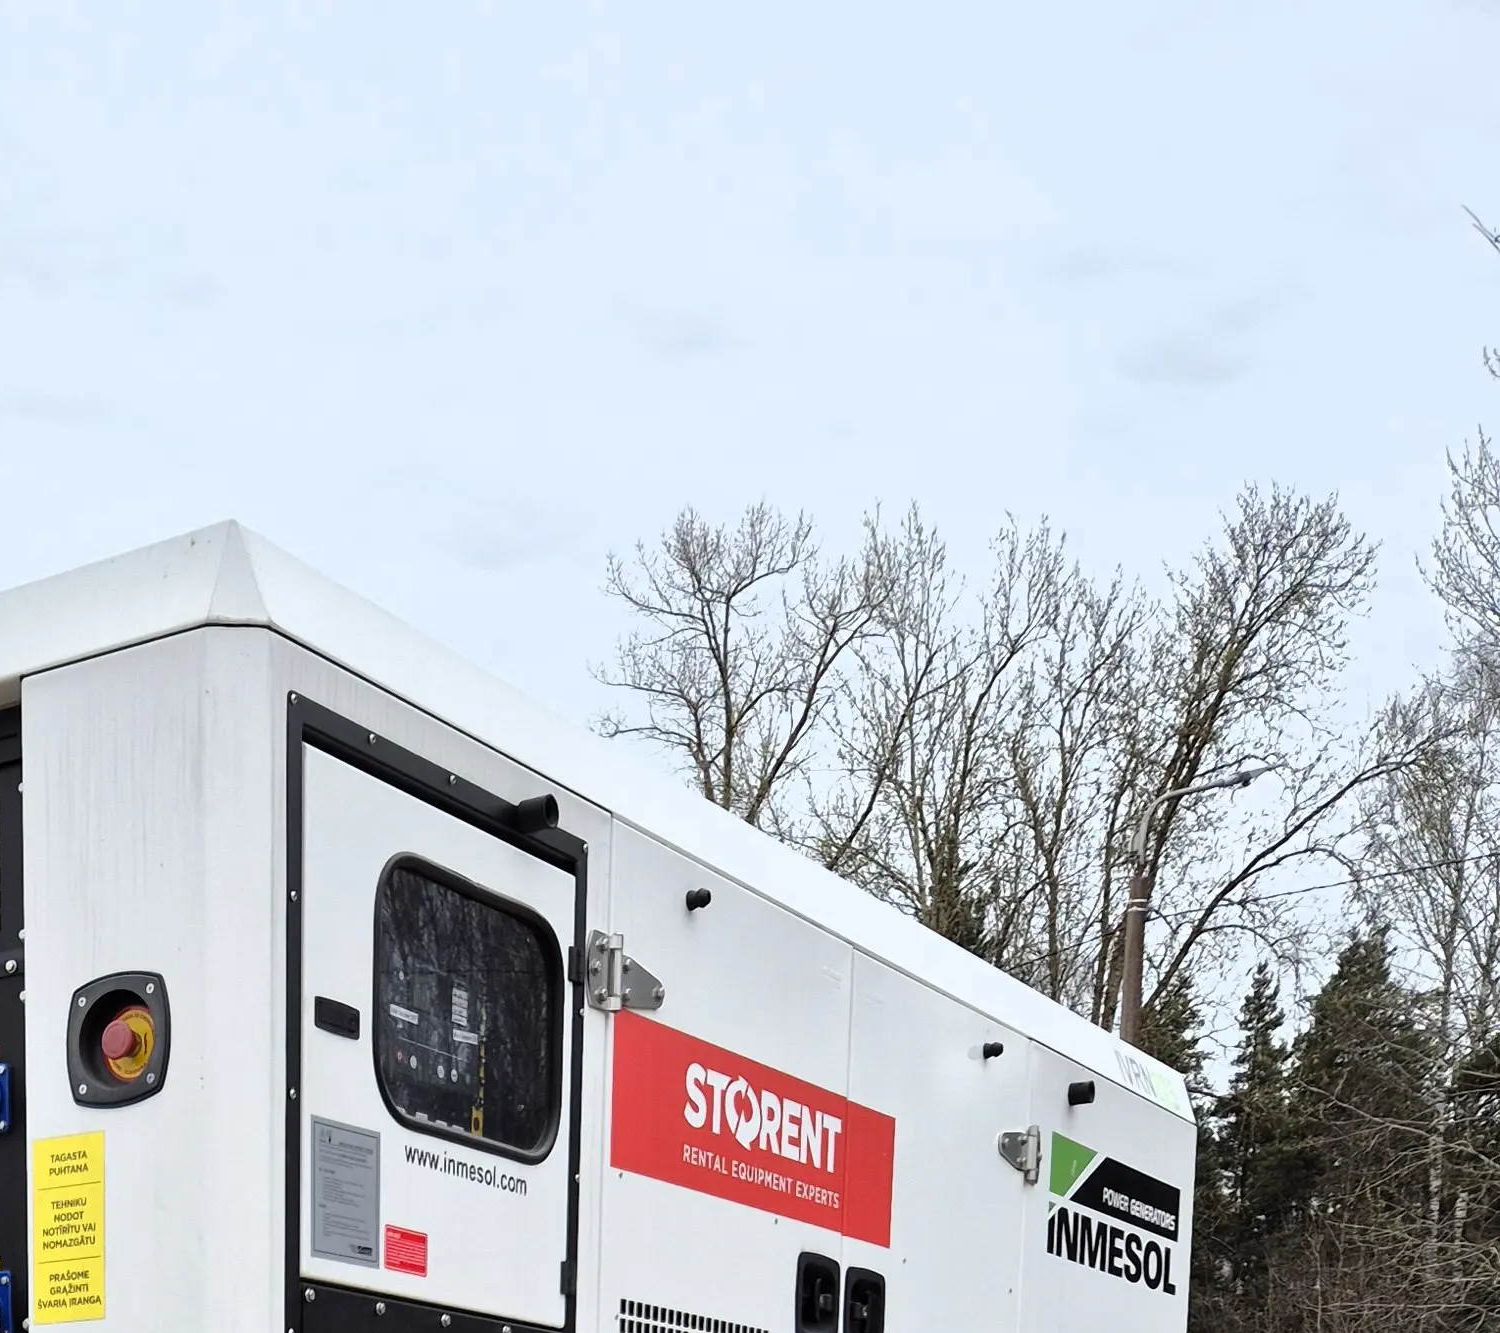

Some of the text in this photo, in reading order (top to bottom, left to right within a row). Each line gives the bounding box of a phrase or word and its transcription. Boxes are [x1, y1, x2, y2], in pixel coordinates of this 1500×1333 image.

[683, 1062, 842, 1174] STORENT
[50, 1150, 88, 1163] TAGASTA
[49, 1163, 89, 1177] PUHTANA
[404, 1144, 528, 1196] www.inmesol.com
[683, 1144, 840, 1209] RENTAL EQUIPMENT EXPERTS
[50, 1197, 87, 1210] TEHNIKU
[1102, 1186, 1176, 1232] POWER GENERATORS
[53, 1211, 84, 1223] NODOT
[42, 1222, 96, 1237] NOTĪRĪTU VAI
[42, 1235, 96, 1251] NOMAZGĀTU
[1046, 1206, 1176, 1296] INMESOL
[49, 1270, 90, 1282] PRAŠOME
[49, 1283, 89, 1296] GRĄŽINTI
[37, 1298, 68, 1310] ŠVARIĄ
